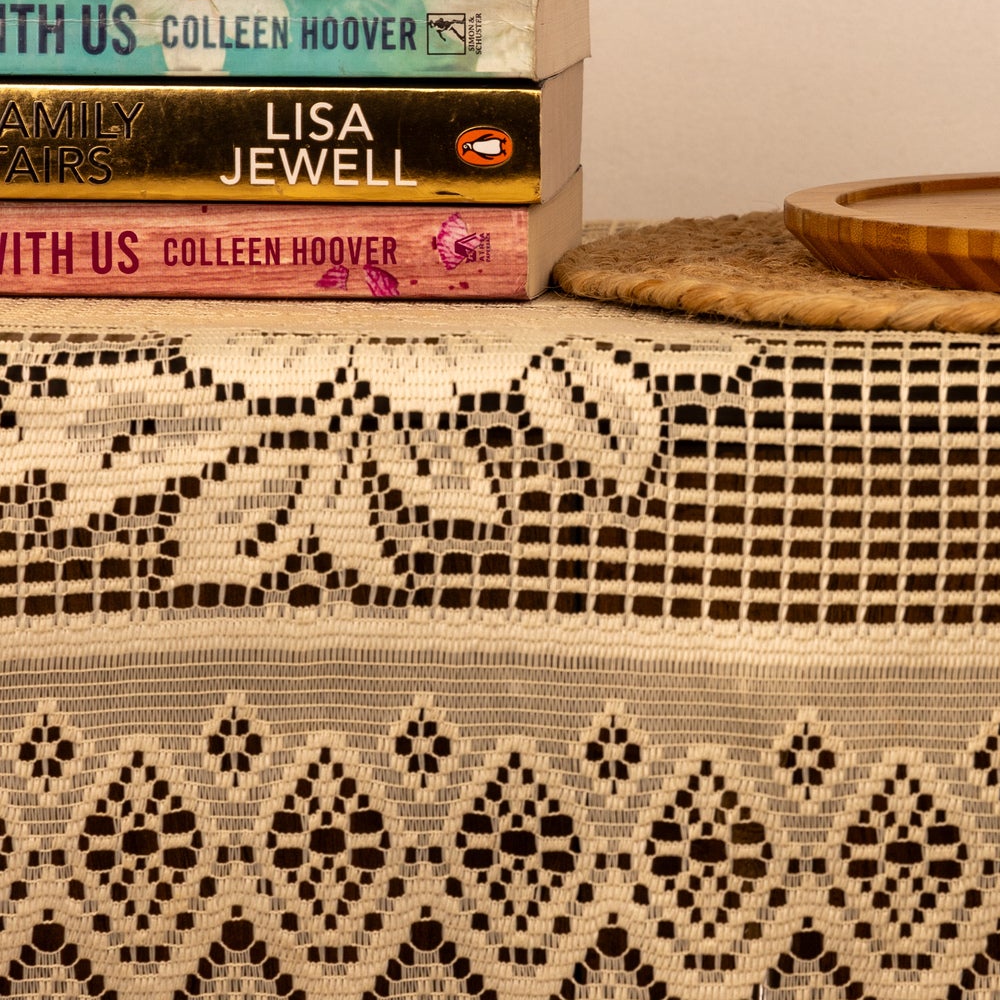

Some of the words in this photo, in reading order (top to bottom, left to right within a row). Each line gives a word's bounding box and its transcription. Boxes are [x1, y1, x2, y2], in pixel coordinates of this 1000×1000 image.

[81, 3, 137, 56] US
[162, 15, 288, 49] COLLEEN
[301, 16, 417, 51] HOOVER
[0, 100, 144, 140] AMILY
[266, 102, 373, 141] LISA
[219, 147, 418, 187] JEWELL
[91, 230, 140, 275] US
[163, 237, 281, 267] COLLEEN
[292, 236, 397, 266] HOOVER
